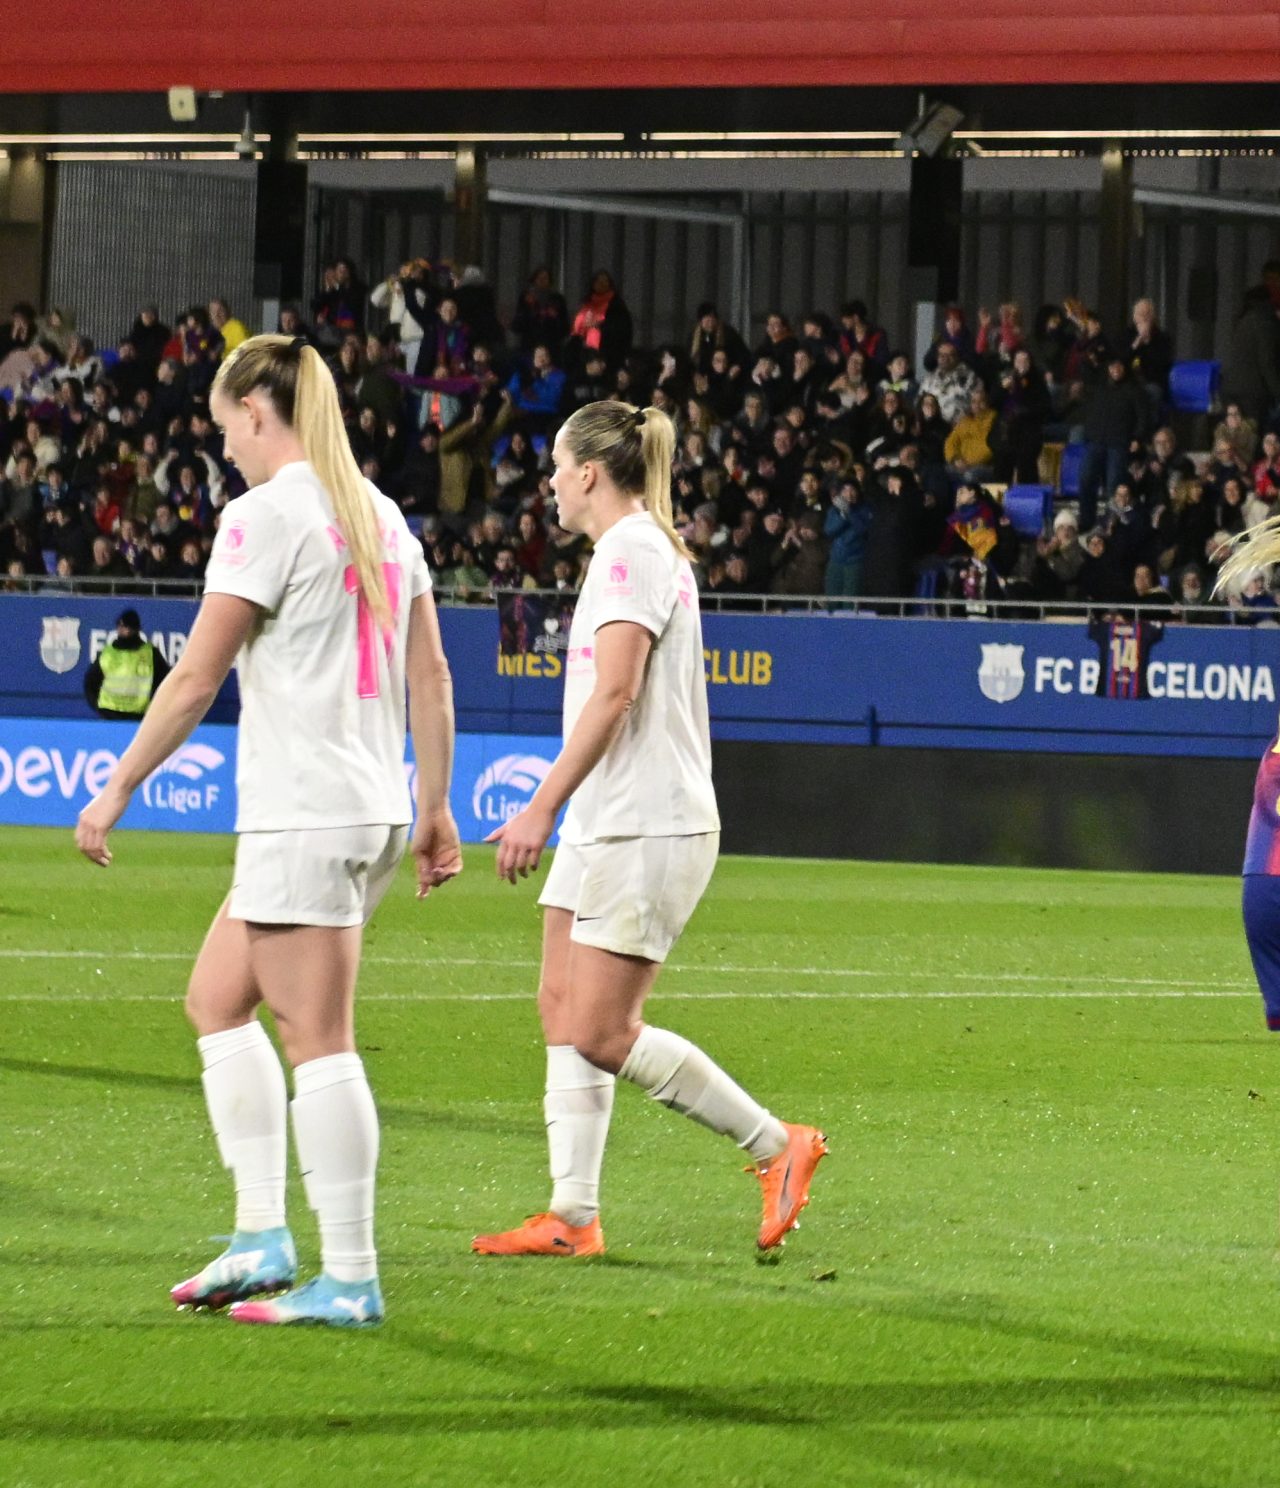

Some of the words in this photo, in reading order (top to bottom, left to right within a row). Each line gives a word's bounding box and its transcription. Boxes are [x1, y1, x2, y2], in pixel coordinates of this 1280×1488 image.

[1110, 637, 1138, 672] 14
[1034, 656, 1074, 694] FC
[1079, 658, 1276, 702] BCELONA
[155, 779, 201, 813] Liga
[205, 784, 220, 810] F
